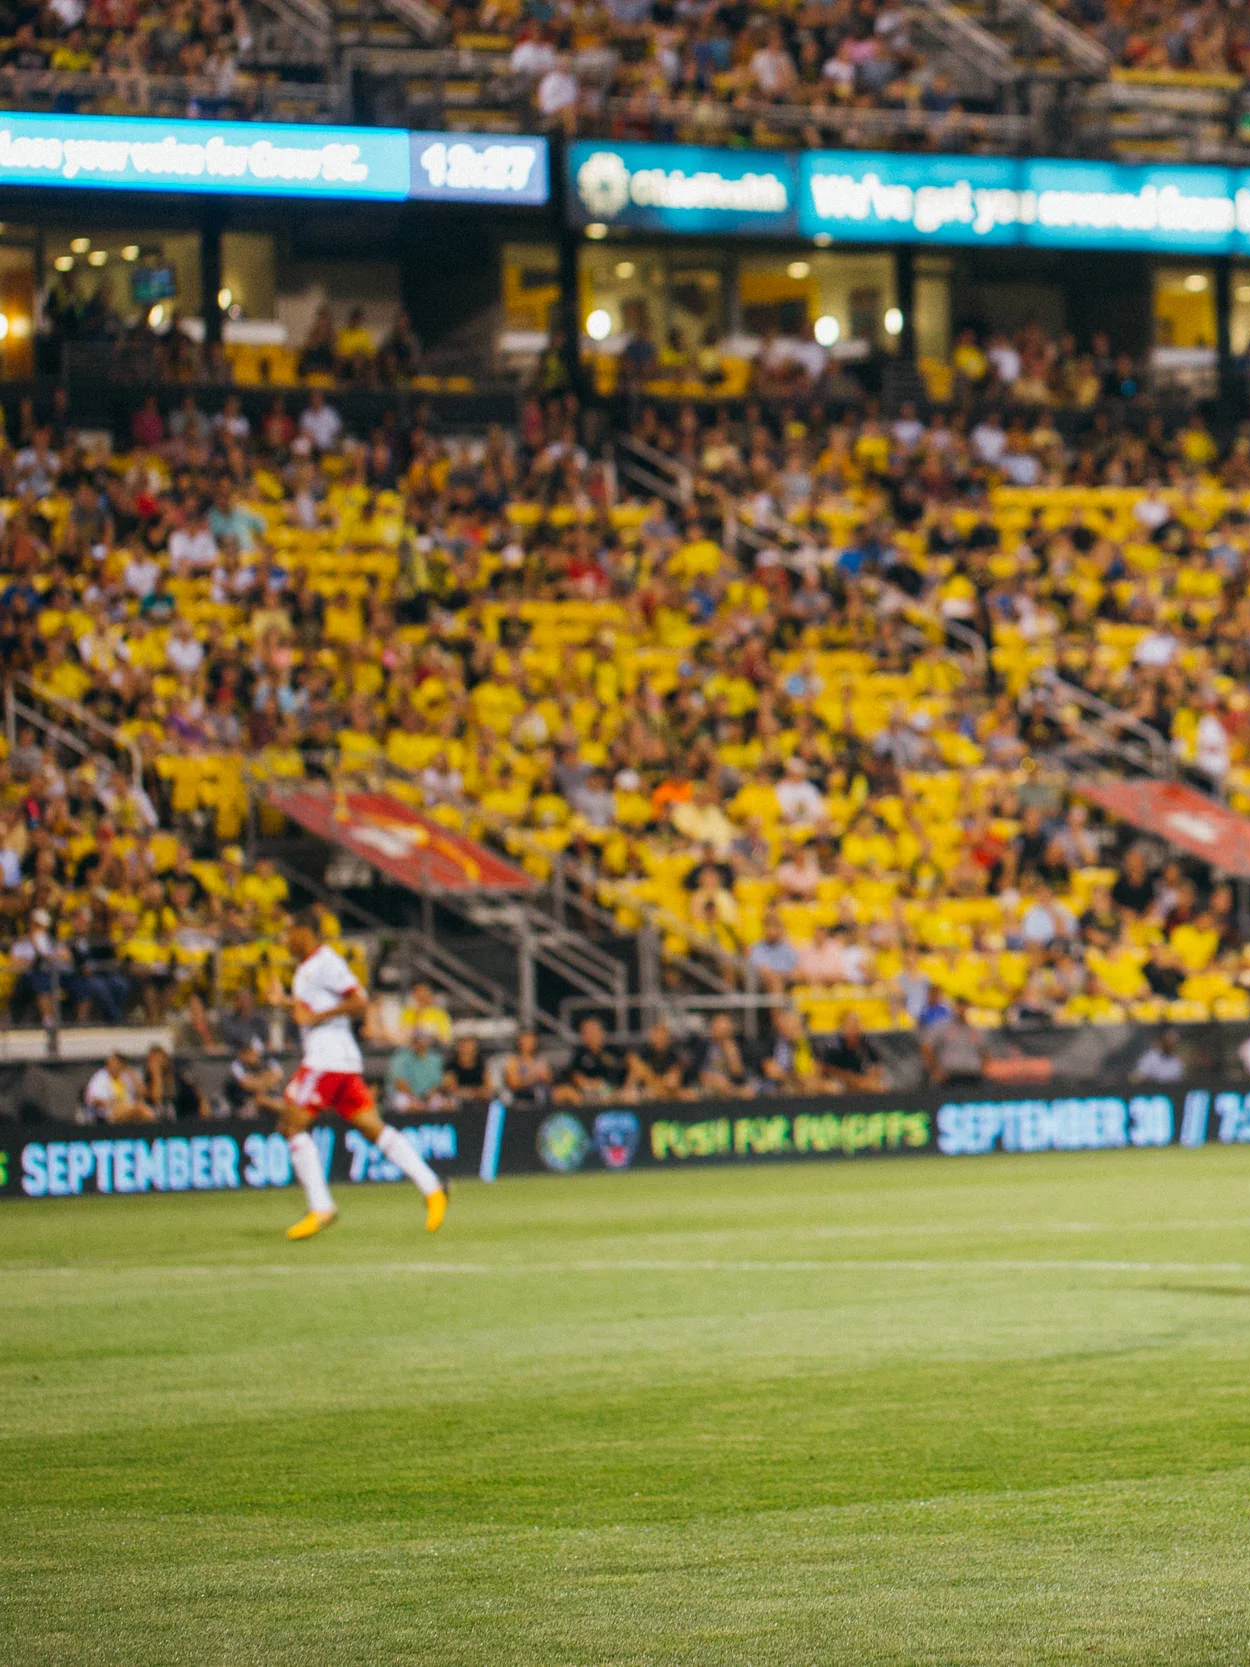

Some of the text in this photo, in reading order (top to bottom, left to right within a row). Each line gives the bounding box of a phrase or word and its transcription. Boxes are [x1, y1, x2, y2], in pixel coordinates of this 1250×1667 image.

[936, 1096, 1128, 1156] SEPTEMBER
[20, 1134, 241, 1197] SEPTEMBER
[243, 1131, 292, 1187] 30
